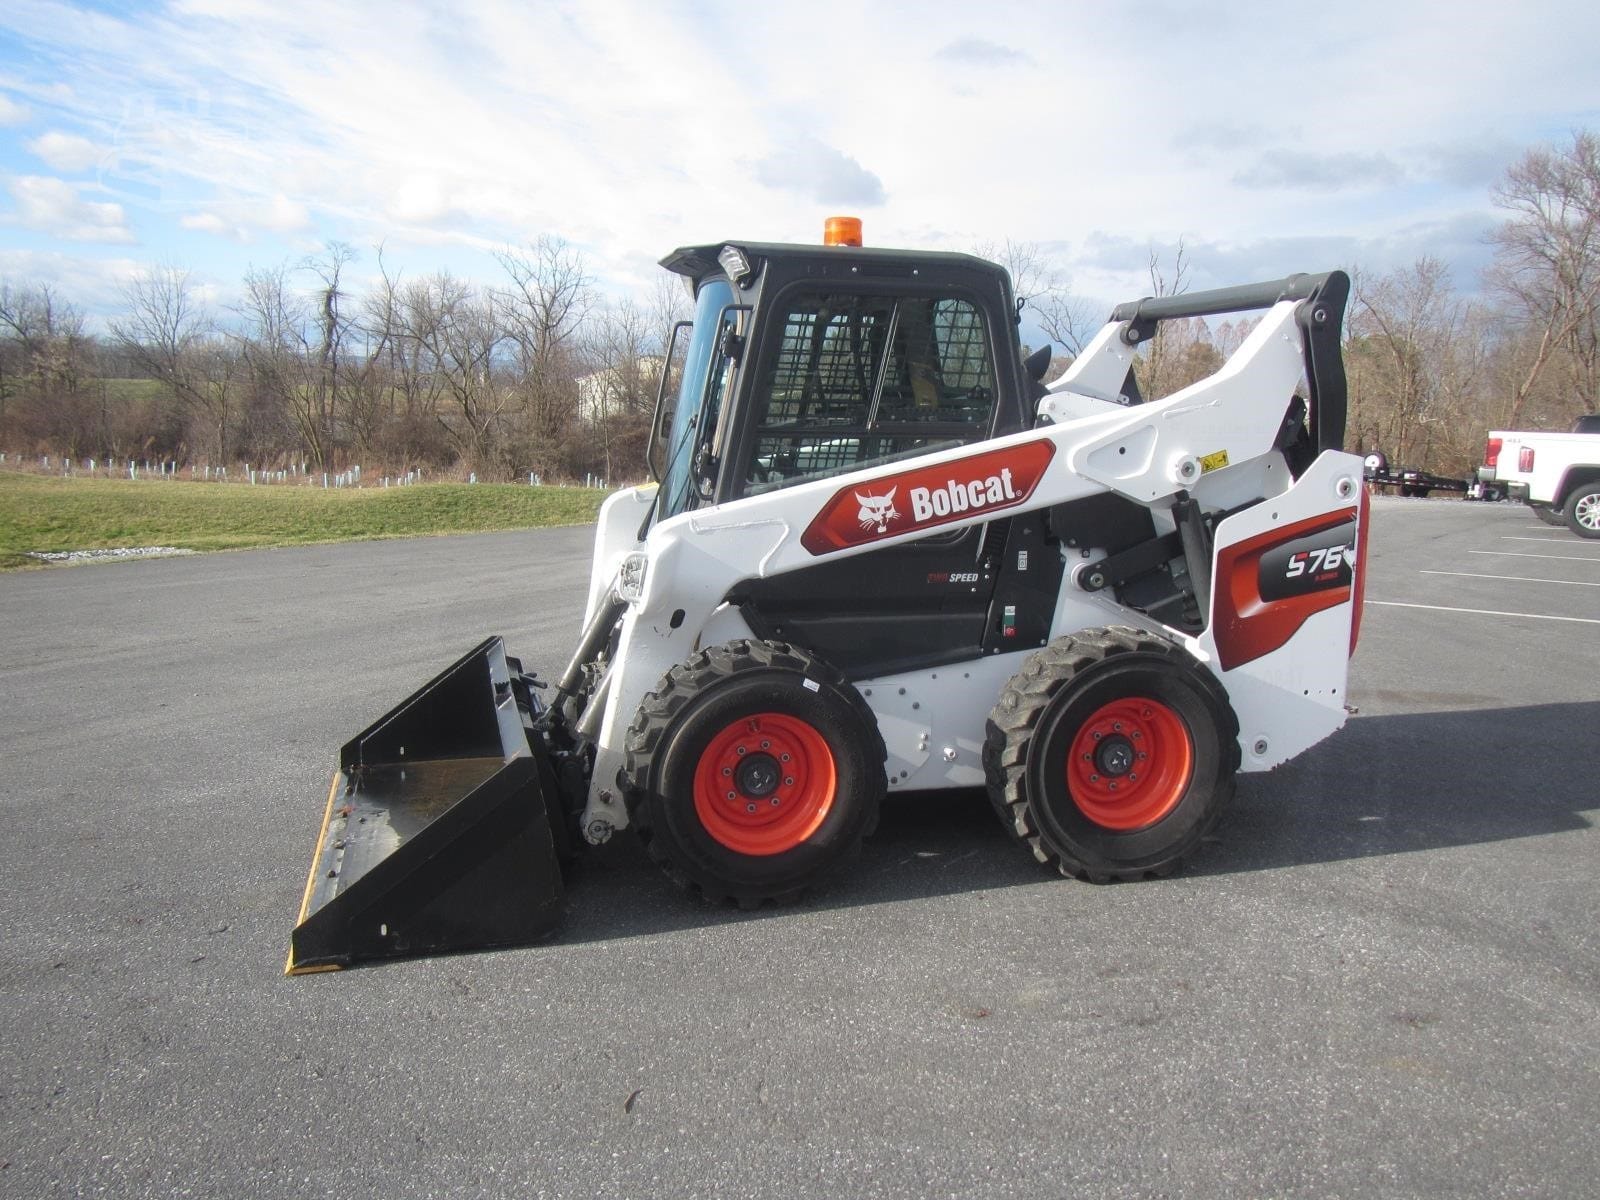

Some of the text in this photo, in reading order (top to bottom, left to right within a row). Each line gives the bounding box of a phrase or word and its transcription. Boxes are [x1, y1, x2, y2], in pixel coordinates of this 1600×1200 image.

[910, 468, 1015, 522] Bobcat
[949, 573, 979, 582] SPEED
[1286, 545, 1345, 578] S76
